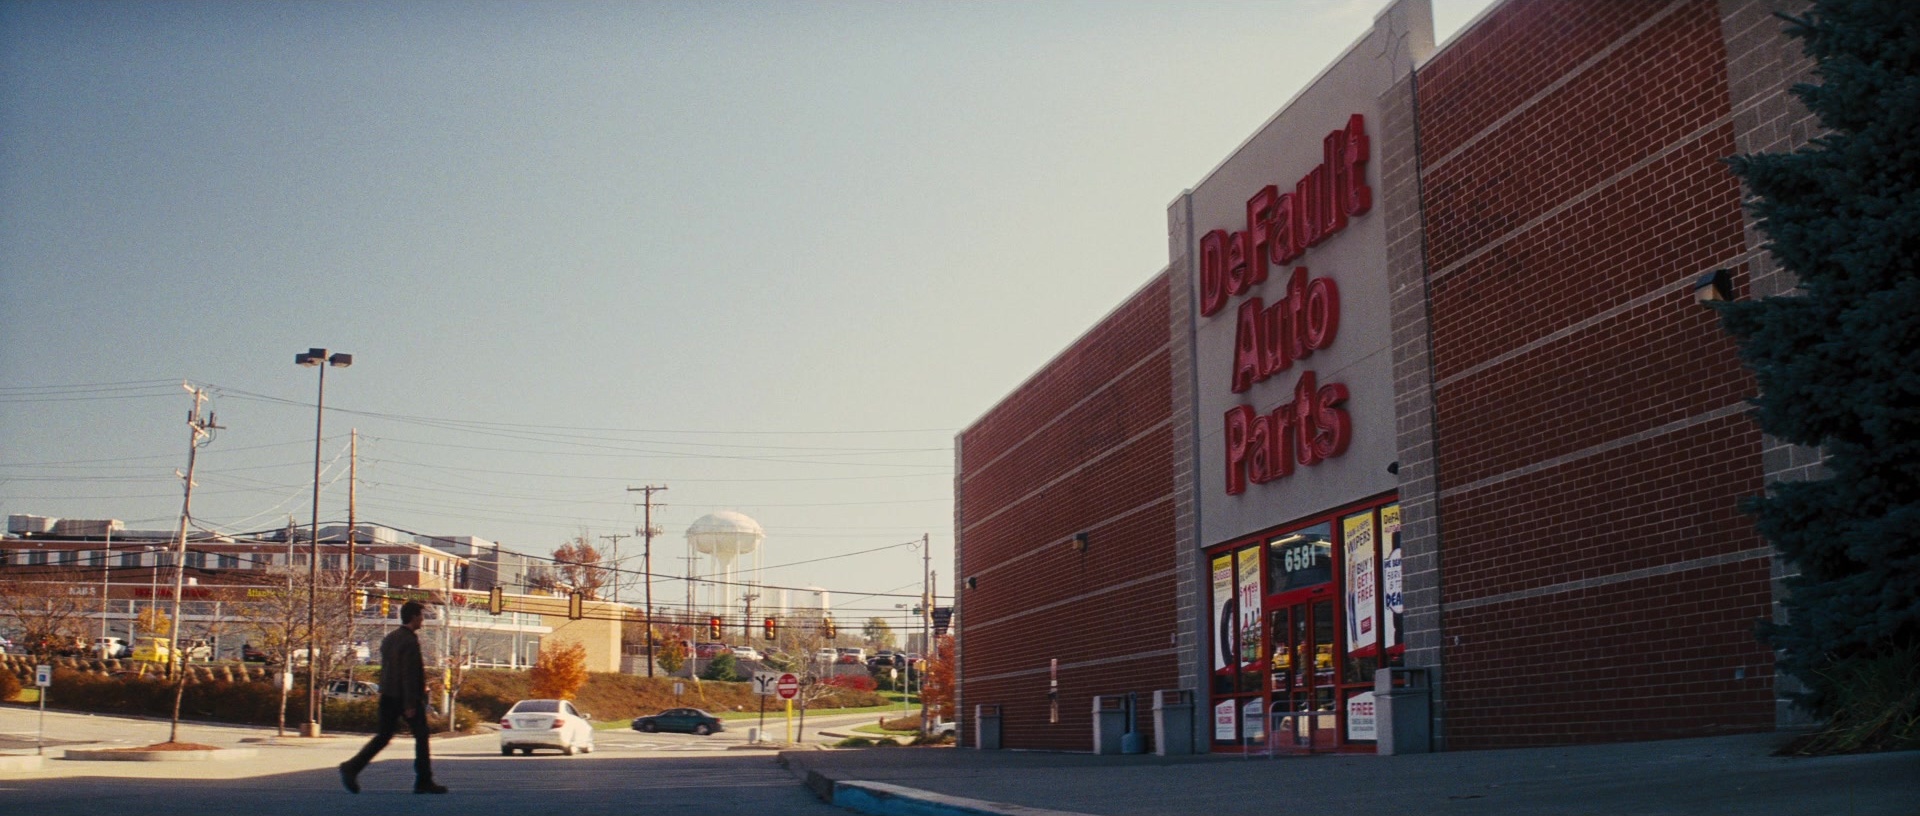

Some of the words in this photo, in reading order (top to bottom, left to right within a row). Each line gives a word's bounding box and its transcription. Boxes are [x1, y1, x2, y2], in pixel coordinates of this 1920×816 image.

[1200, 114, 1372, 317] DeFault
[1231, 266, 1340, 394] Auto
[1224, 370, 1352, 496] Parts
[1347, 528, 1371, 554] WIPERS
[1285, 544, 1316, 572] 6581
[1357, 560, 1368, 575] BUY
[1357, 572, 1369, 589] GET
[1357, 585, 1373, 604] FREE
[1351, 702, 1374, 716] FREE
